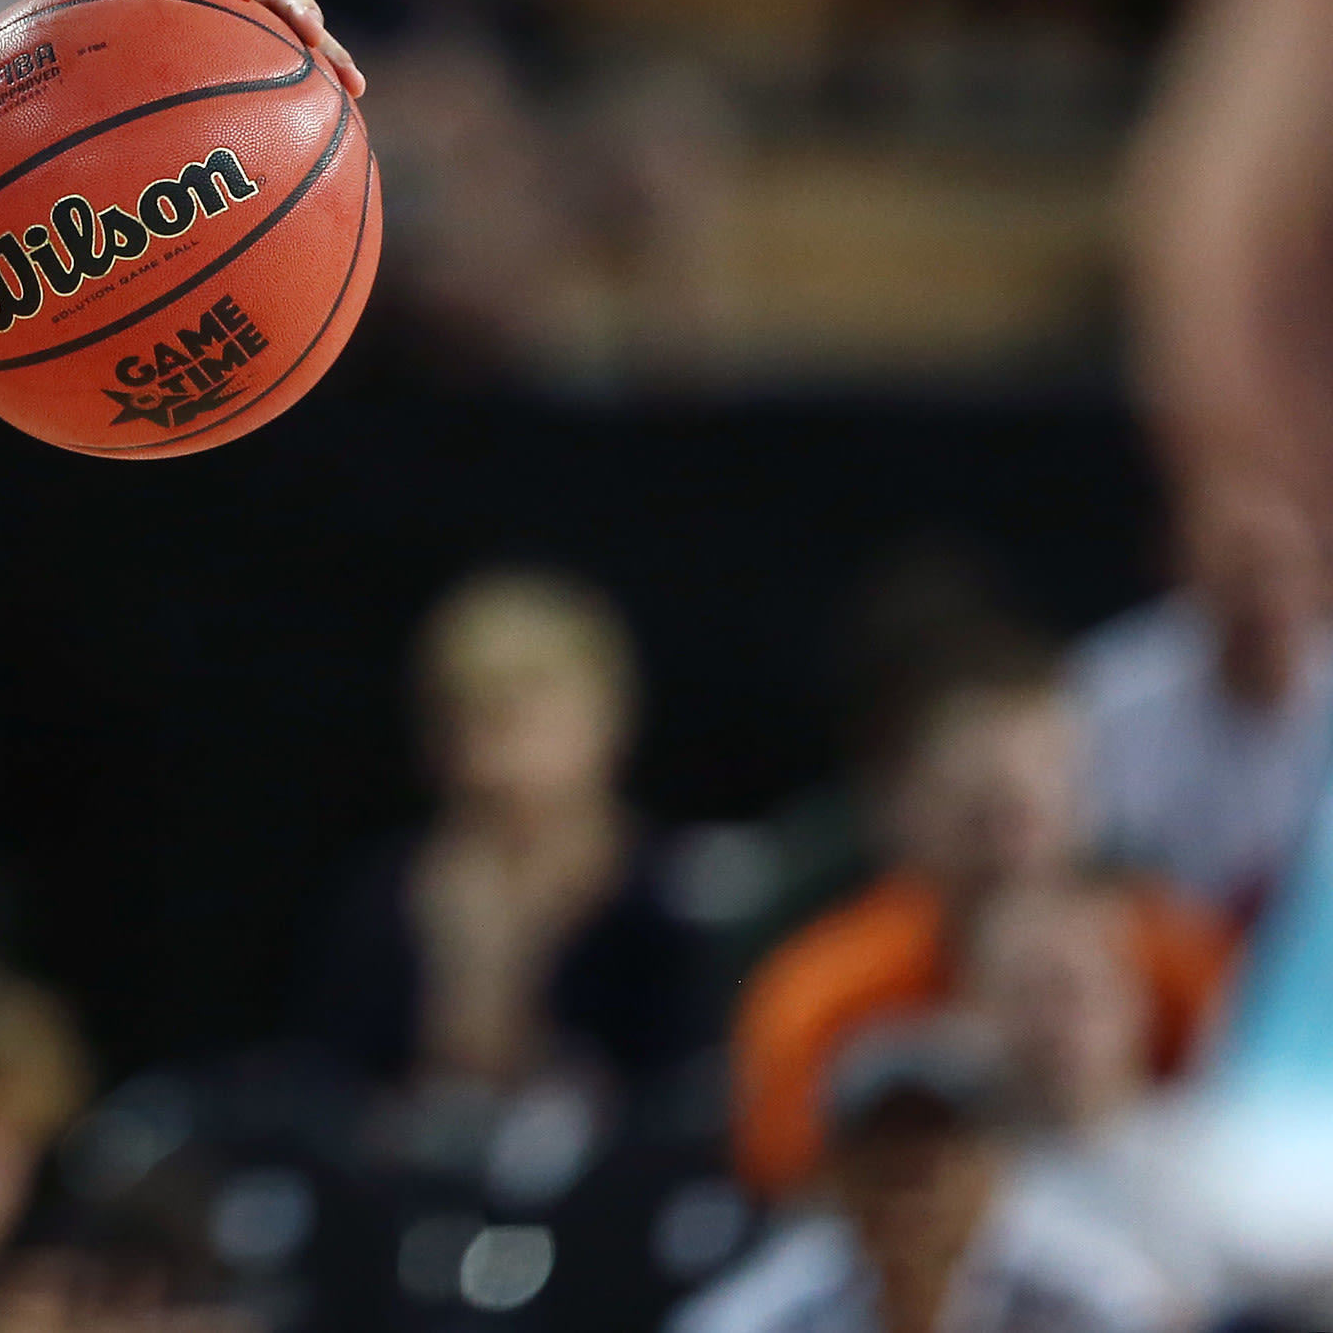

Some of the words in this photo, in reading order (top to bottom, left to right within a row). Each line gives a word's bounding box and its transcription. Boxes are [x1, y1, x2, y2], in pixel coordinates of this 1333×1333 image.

[50, 283, 116, 324] SOLUTION
[118, 258, 159, 285] GAME
[162, 239, 200, 261] BALL
[115, 293, 249, 388] GAME
[157, 322, 270, 394] TIME
